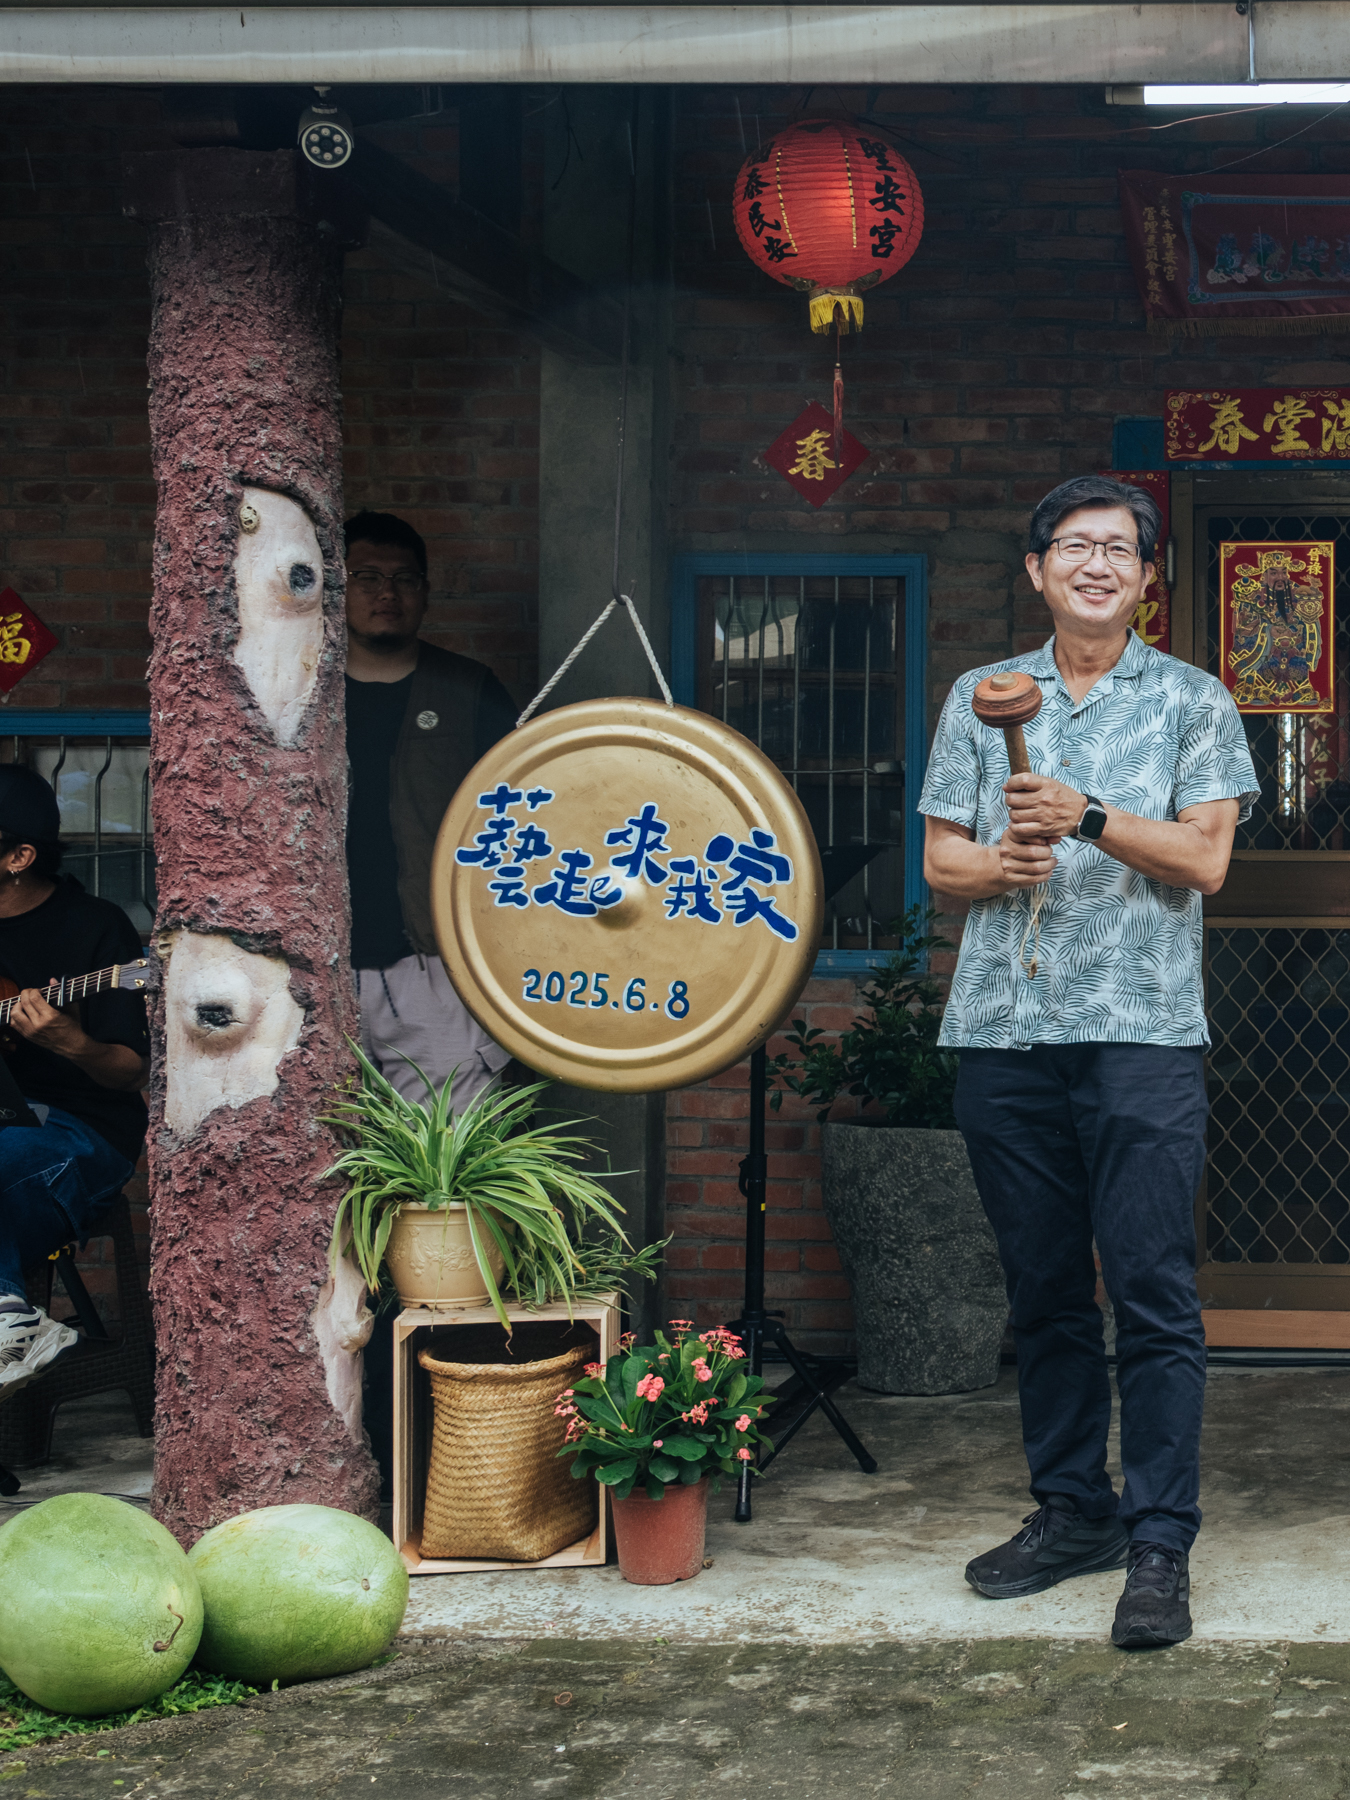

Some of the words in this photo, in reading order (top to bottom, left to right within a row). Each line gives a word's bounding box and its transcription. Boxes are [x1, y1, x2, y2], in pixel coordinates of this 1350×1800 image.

[855, 136, 907, 260] 聖安宮
[1159, 188, 1179, 282] 永安聖安宮
[787, 429, 844, 481] 春
[455, 782, 800, 943] 藝起來我家
[520, 967, 691, 1020] 2025.6.8
